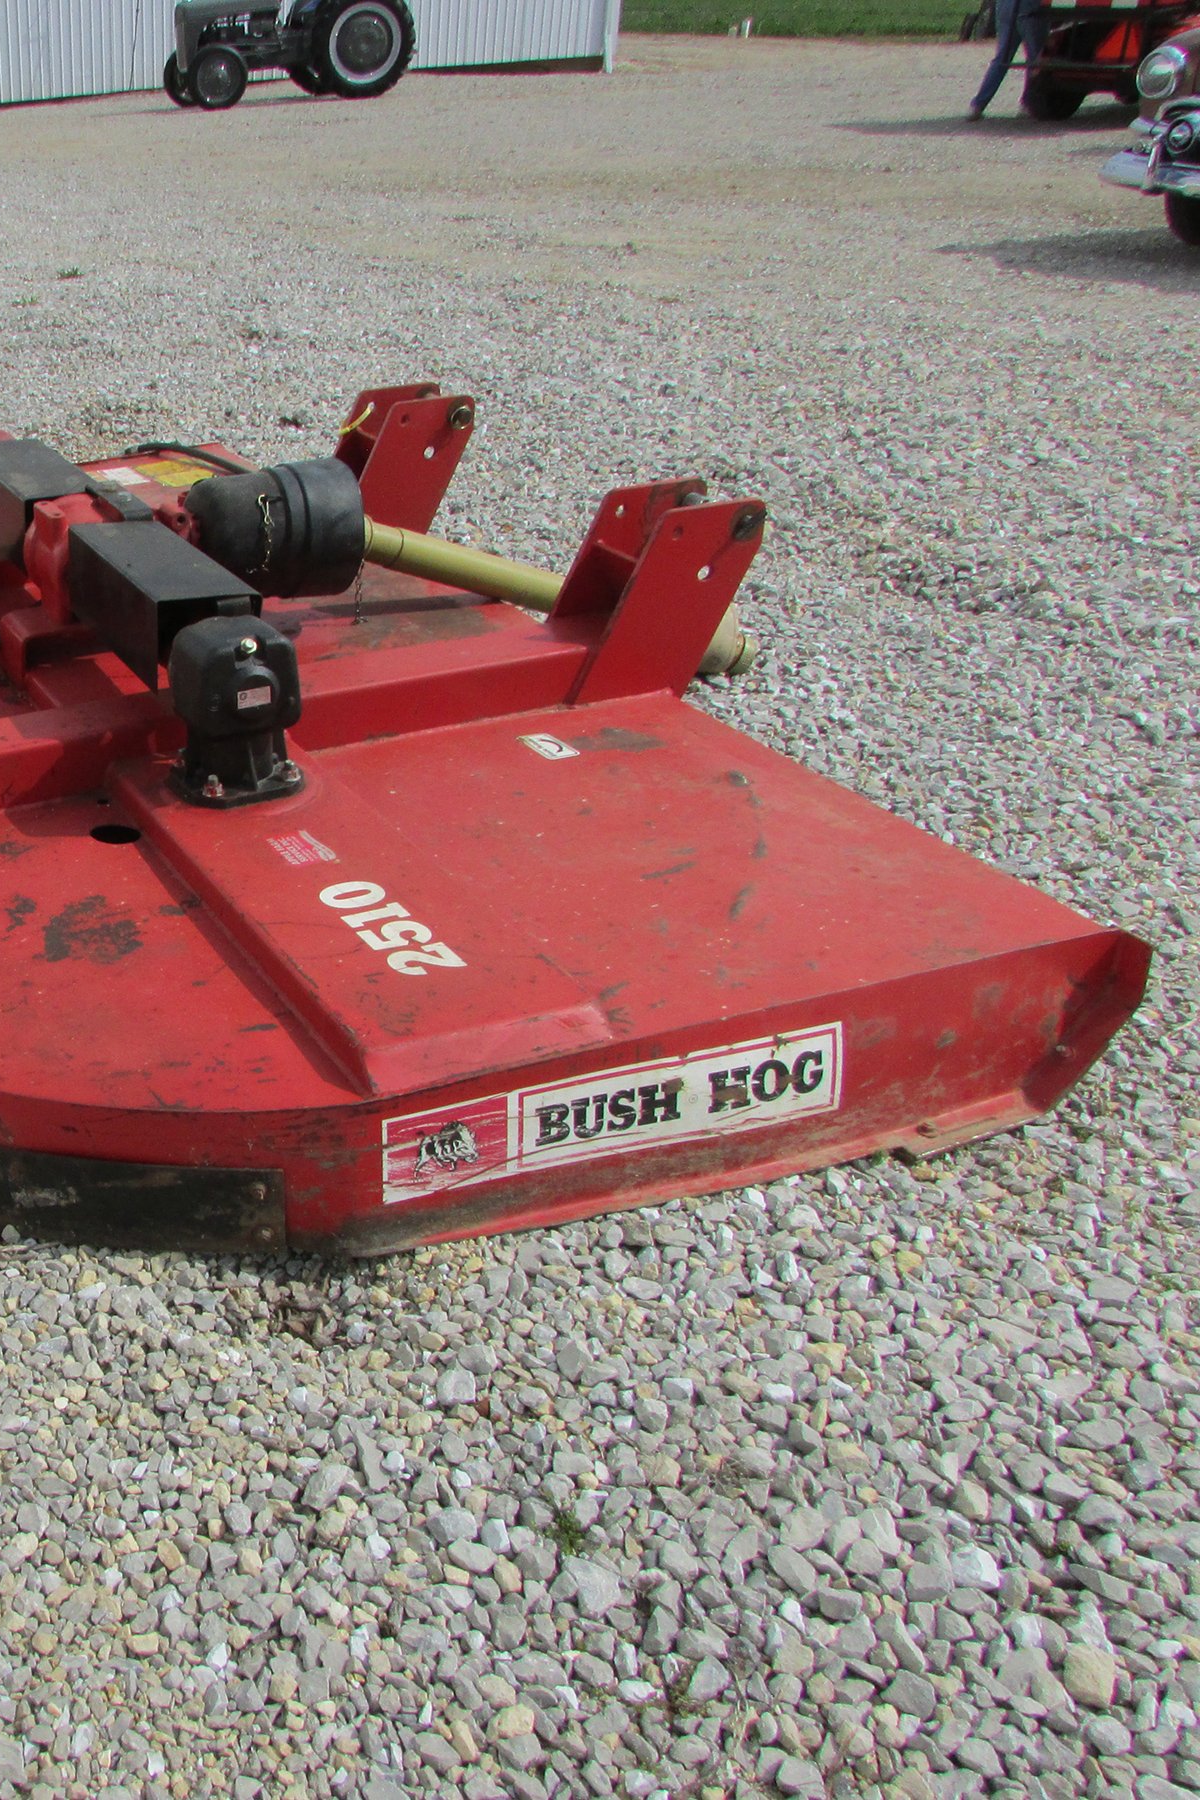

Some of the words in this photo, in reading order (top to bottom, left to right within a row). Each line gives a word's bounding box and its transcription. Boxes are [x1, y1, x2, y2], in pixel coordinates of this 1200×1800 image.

[319, 881, 467, 976] 2510
[535, 1081, 681, 1147] BUSH
[708, 1049, 824, 1114] HOG
